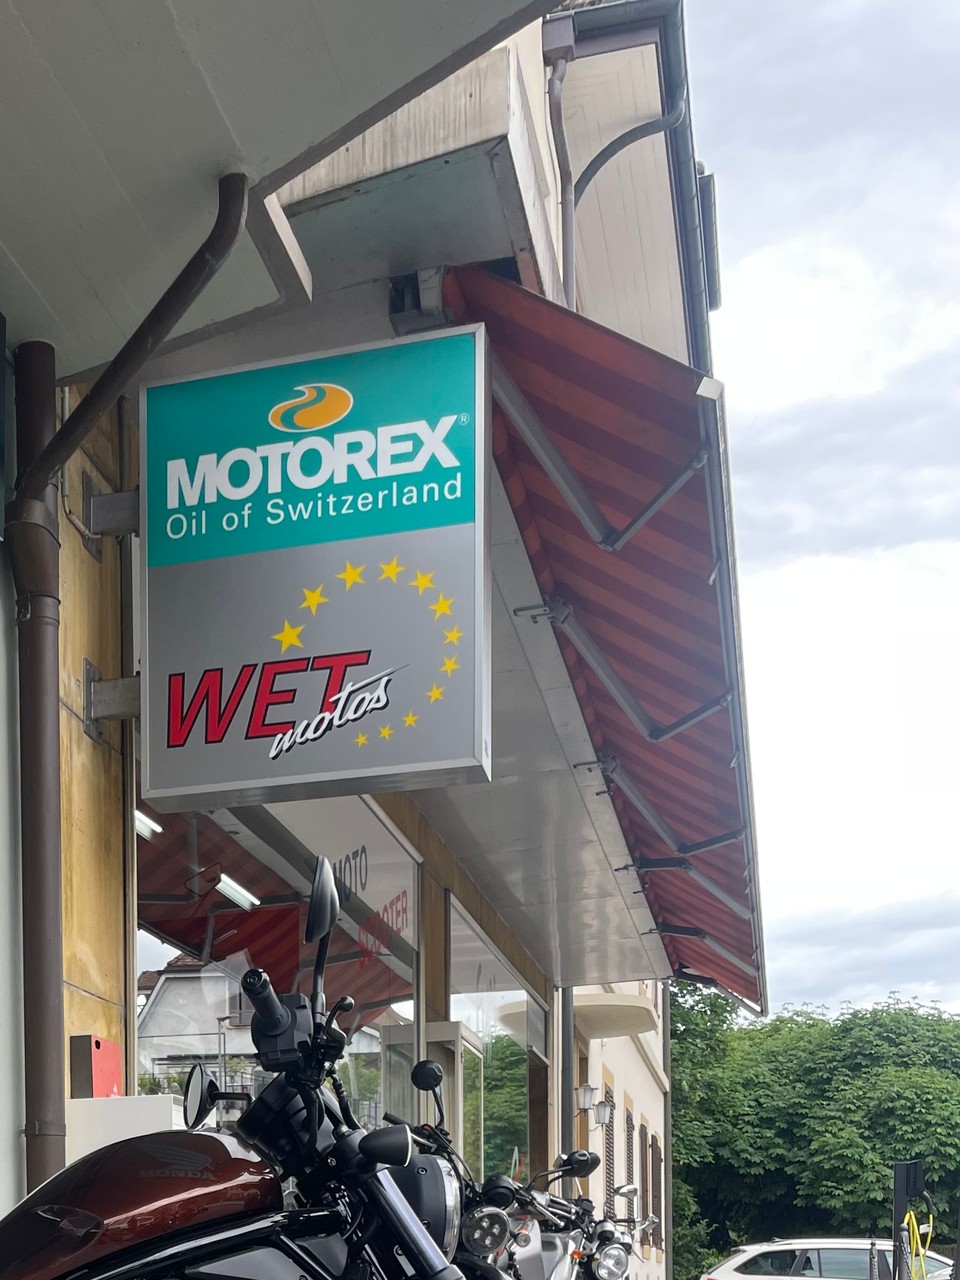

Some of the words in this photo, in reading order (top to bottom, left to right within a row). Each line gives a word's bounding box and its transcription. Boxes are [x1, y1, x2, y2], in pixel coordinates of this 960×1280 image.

[166, 414, 460, 509] MOTOREX
[166, 511, 206, 539] Oil
[222, 503, 253, 528] of
[266, 473, 462, 525] Switzerland
[167, 649, 372, 749] WET
[268, 664, 409, 760] motos
[358, 889, 408, 970] SCOOTER
[140, 1169, 217, 1180] HONDA
